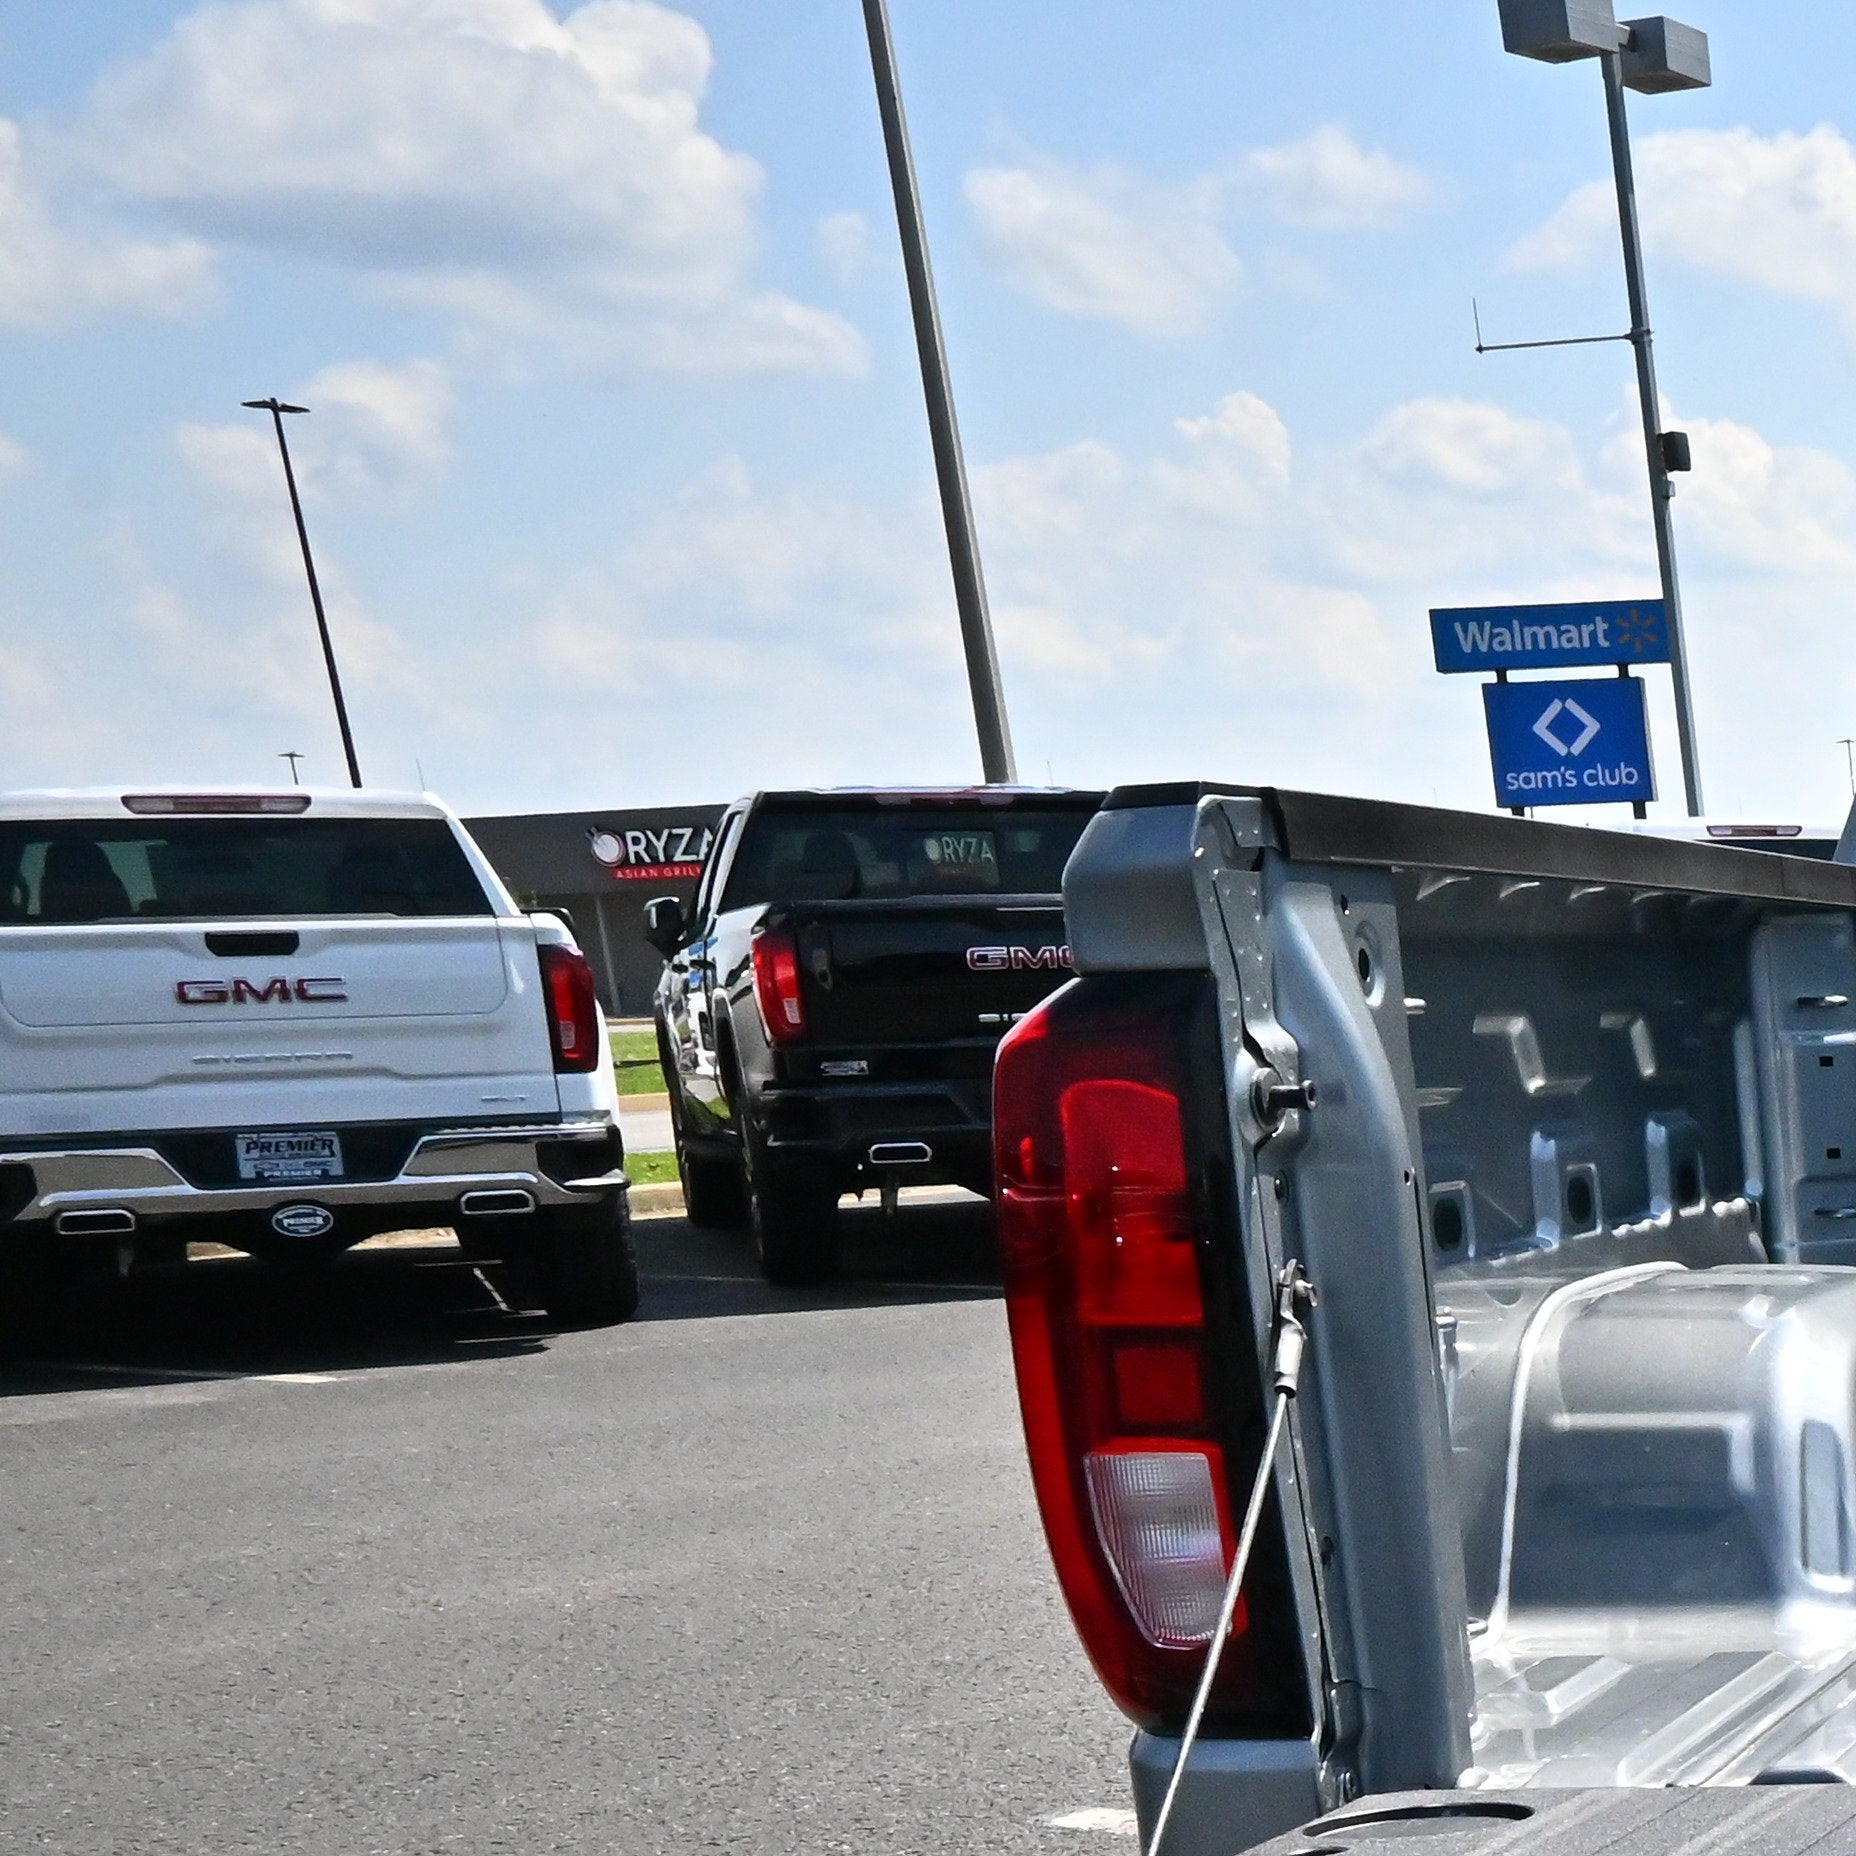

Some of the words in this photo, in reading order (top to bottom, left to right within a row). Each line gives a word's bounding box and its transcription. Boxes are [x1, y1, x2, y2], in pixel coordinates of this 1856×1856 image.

[1454, 616, 1610, 653] Walmart
[1506, 766, 1577, 791] sam's
[1584, 762, 1638, 786] club
[616, 868, 658, 880] ASIAN
[175, 976, 348, 1004] GMC
[245, 1137, 336, 1157] PREMIER
